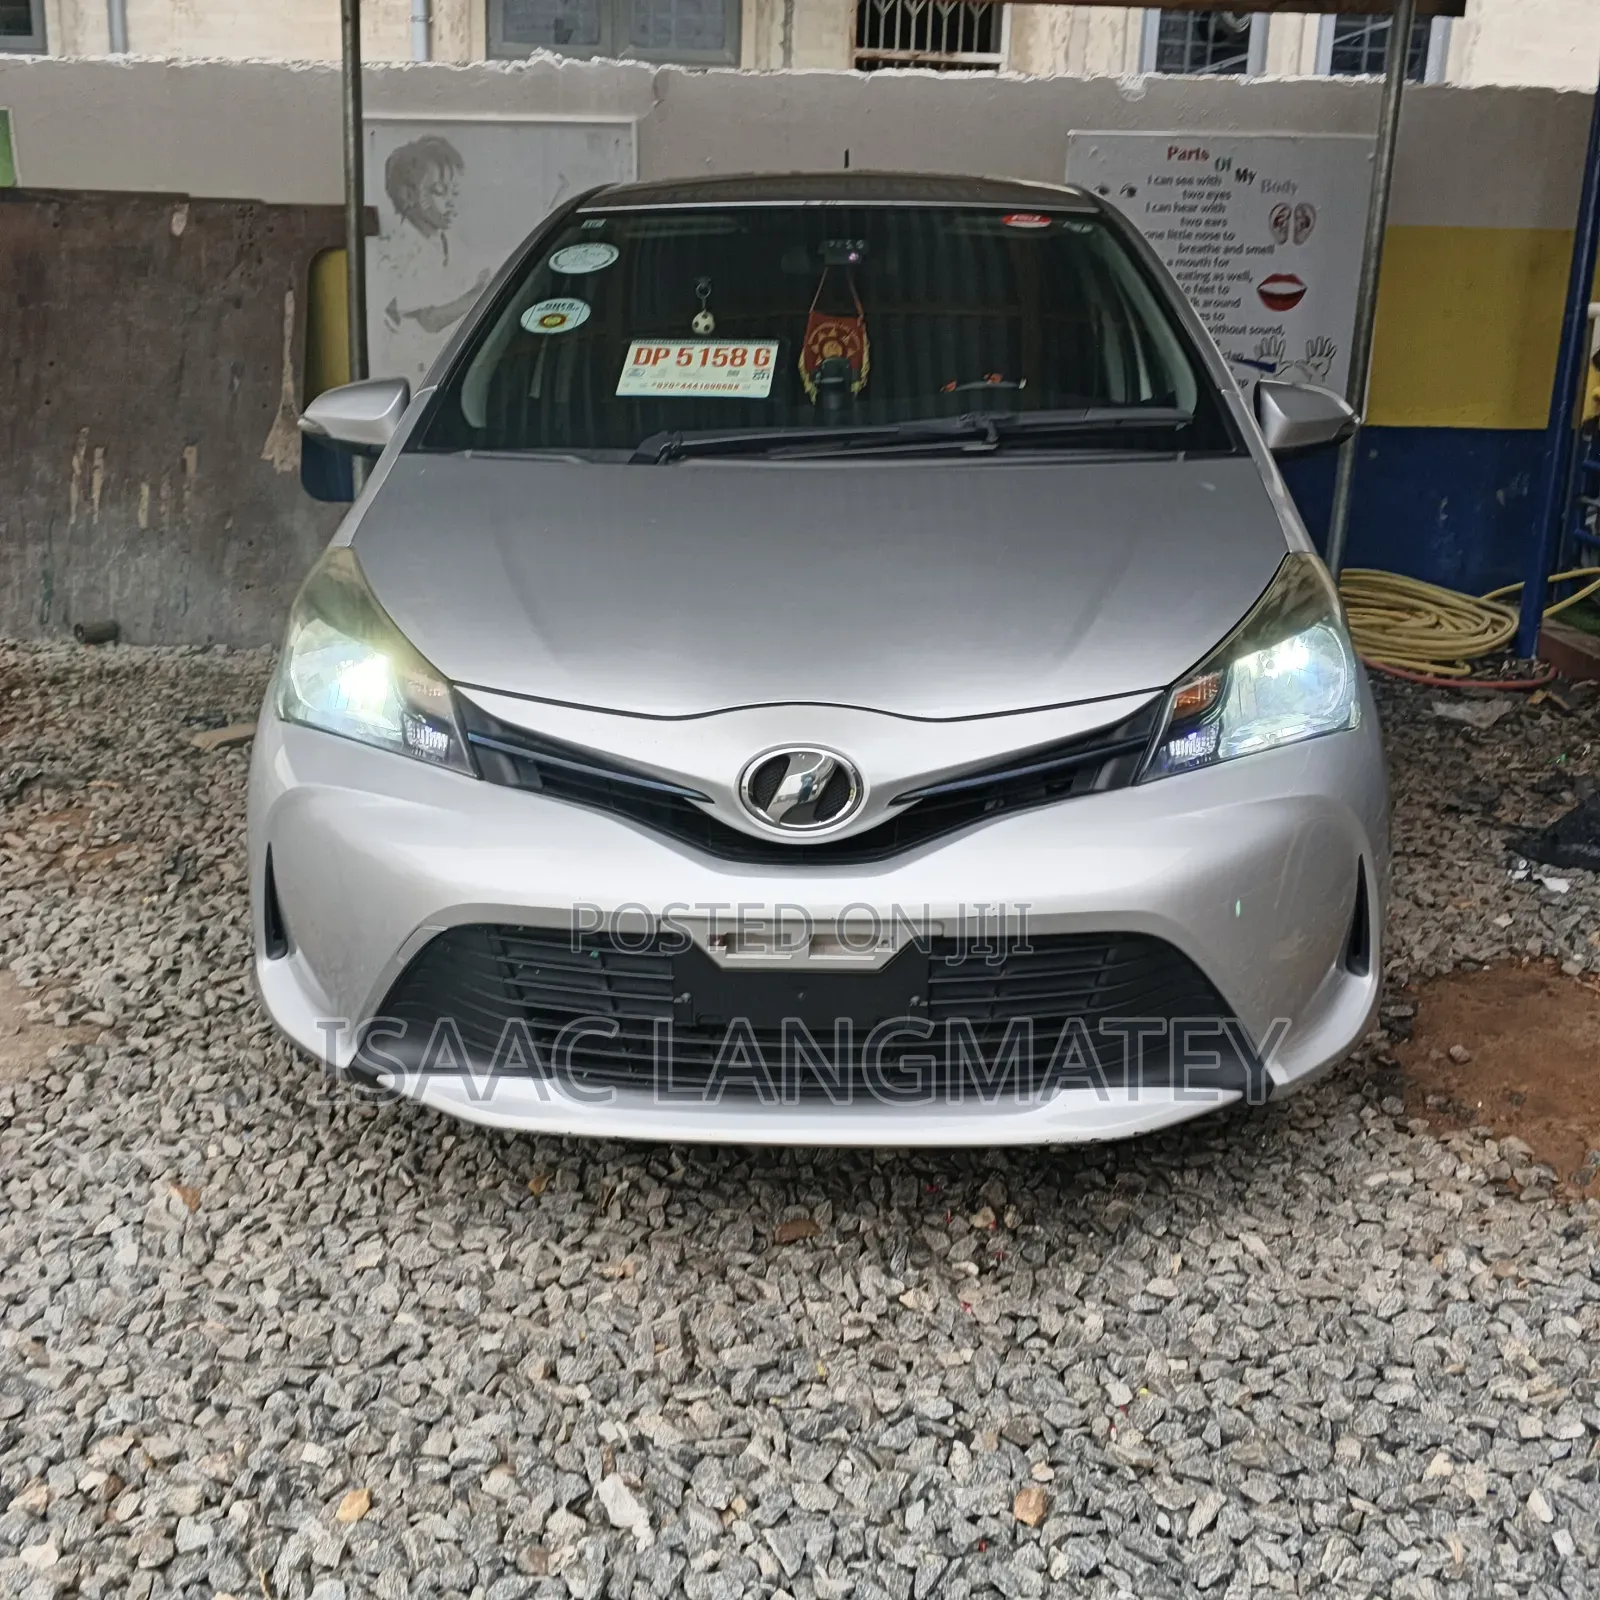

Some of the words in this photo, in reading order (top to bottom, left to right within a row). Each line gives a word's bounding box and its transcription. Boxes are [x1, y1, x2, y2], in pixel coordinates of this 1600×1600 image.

[1167, 146, 1210, 162] Parts
[1214, 156, 1234, 172] Of
[1234, 167, 1257, 185] My
[1260, 178, 1299, 196] Body
[1147, 174, 1153, 186] I
[1154, 176, 1173, 186] can
[1175, 176, 1194, 186] see
[1196, 175, 1222, 187] with
[1182, 189, 1205, 200] two
[1206, 190, 1232, 204] eyes
[1145, 202, 1151, 213] I
[1152, 203, 1171, 213] can
[1173, 202, 1198, 213] hear
[1200, 202, 1227, 214] with
[1180, 216, 1201, 227] two
[1204, 217, 1228, 228] ears
[1167, 229, 1193, 241] little
[1194, 231, 1220, 241] nose
[1223, 230, 1236, 241] to
[1177, 243, 1220, 255] breathe
[1222, 243, 1244, 255] and
[1245, 243, 1275, 255] smell
[1175, 257, 1212, 268] mouth
[1213, 257, 1230, 268] for
[1176, 271, 1211, 284] eating
[1212, 273, 1224, 282] as
[1193, 284, 1216, 295] feet
[1217, 284, 1230, 295] to
[1202, 297, 1242, 309] around
[1213, 311, 1226, 321] to
[1249, 324, 1285, 337] sound,
[632, 347, 670, 367] DP
[675, 347, 748, 367] 5158
[753, 347, 771, 367] G
